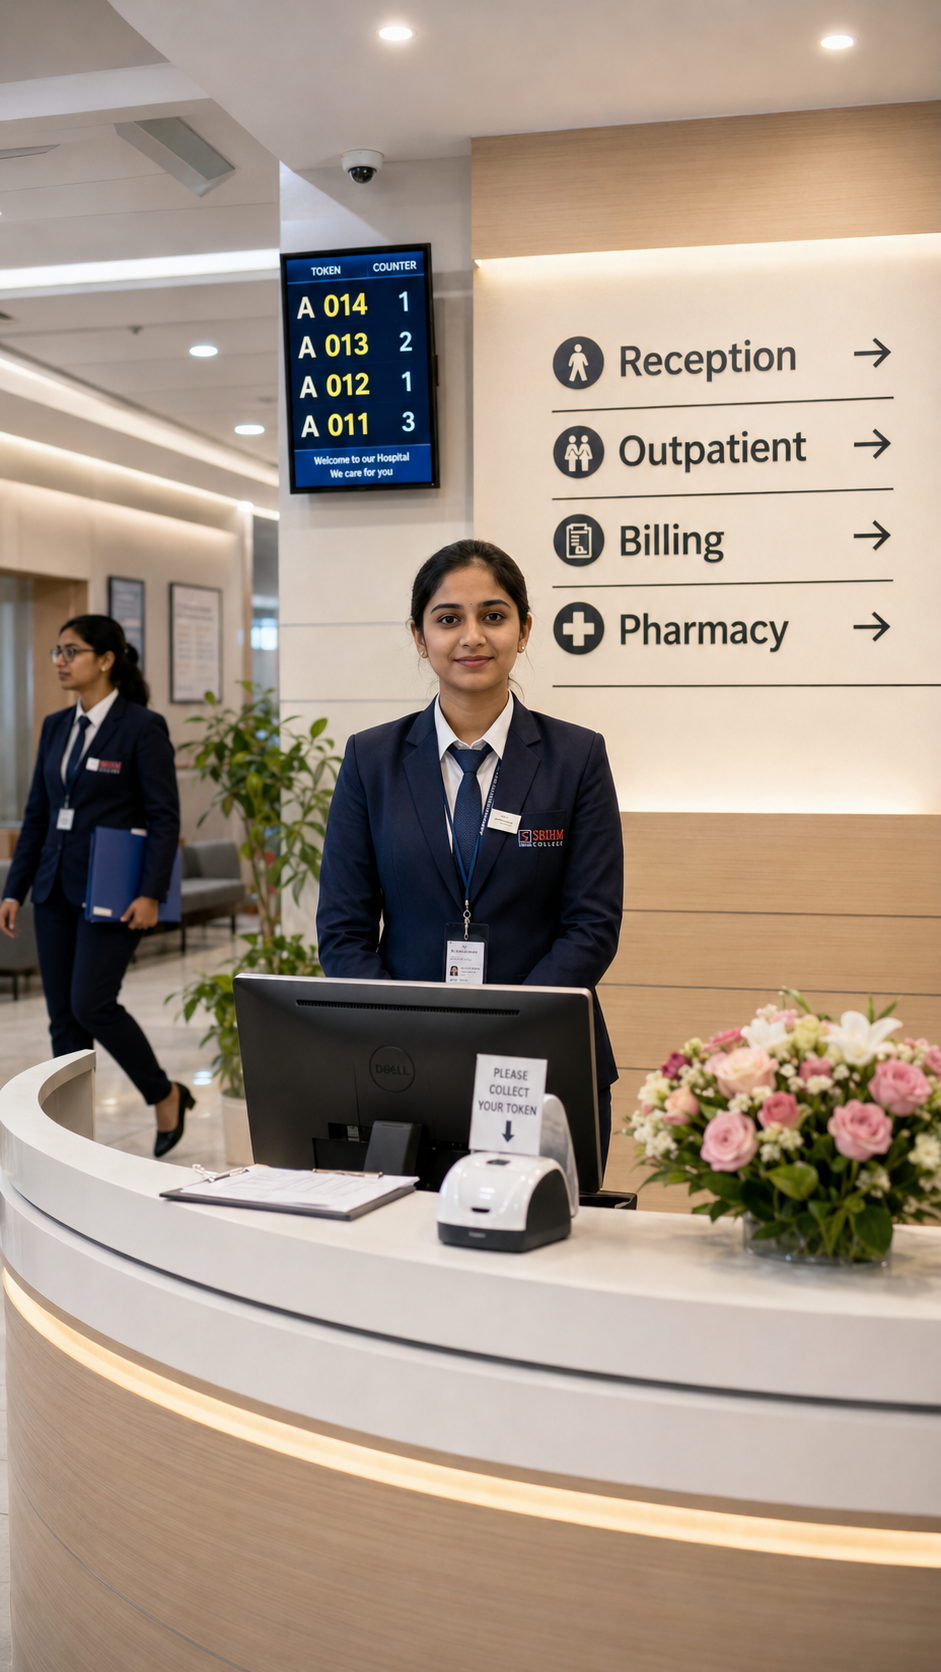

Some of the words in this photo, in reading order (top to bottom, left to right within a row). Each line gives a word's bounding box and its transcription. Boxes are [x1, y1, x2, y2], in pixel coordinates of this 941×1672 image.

[311, 265, 341, 276] TOKEN
[372, 260, 417, 272] COUNTER
[297, 296, 315, 319] A
[324, 293, 368, 317] 014
[399, 291, 408, 312] 1
[298, 336, 316, 359] A
[325, 333, 369, 357] 013
[399, 331, 413, 352] 2
[620, 340, 796, 382] Reception
[300, 376, 318, 398] A
[326, 373, 370, 397] 012
[402, 371, 411, 392] 1
[301, 415, 319, 437] A
[328, 413, 368, 436] 011
[402, 411, 415, 432] 3
[313, 456, 350, 465] Welcome
[351, 455, 360, 464] to
[361, 454, 376, 463] our
[377, 452, 410, 463] Hospital
[619, 431, 807, 473] Outpatient
[330, 469, 343, 478] We
[344, 469, 362, 478] care
[364, 468, 376, 477] for
[377, 468, 393, 478] you
[620, 523, 724, 563] Billing
[620, 613, 789, 652] Pharmacy
[532, 829, 564, 841] SBIHM
[494, 1067, 528, 1081] PLEASE
[489, 1084, 530, 1098] COLLECT
[478, 1100, 503, 1113] YOUR
[506, 1103, 537, 1116] TOKEN
